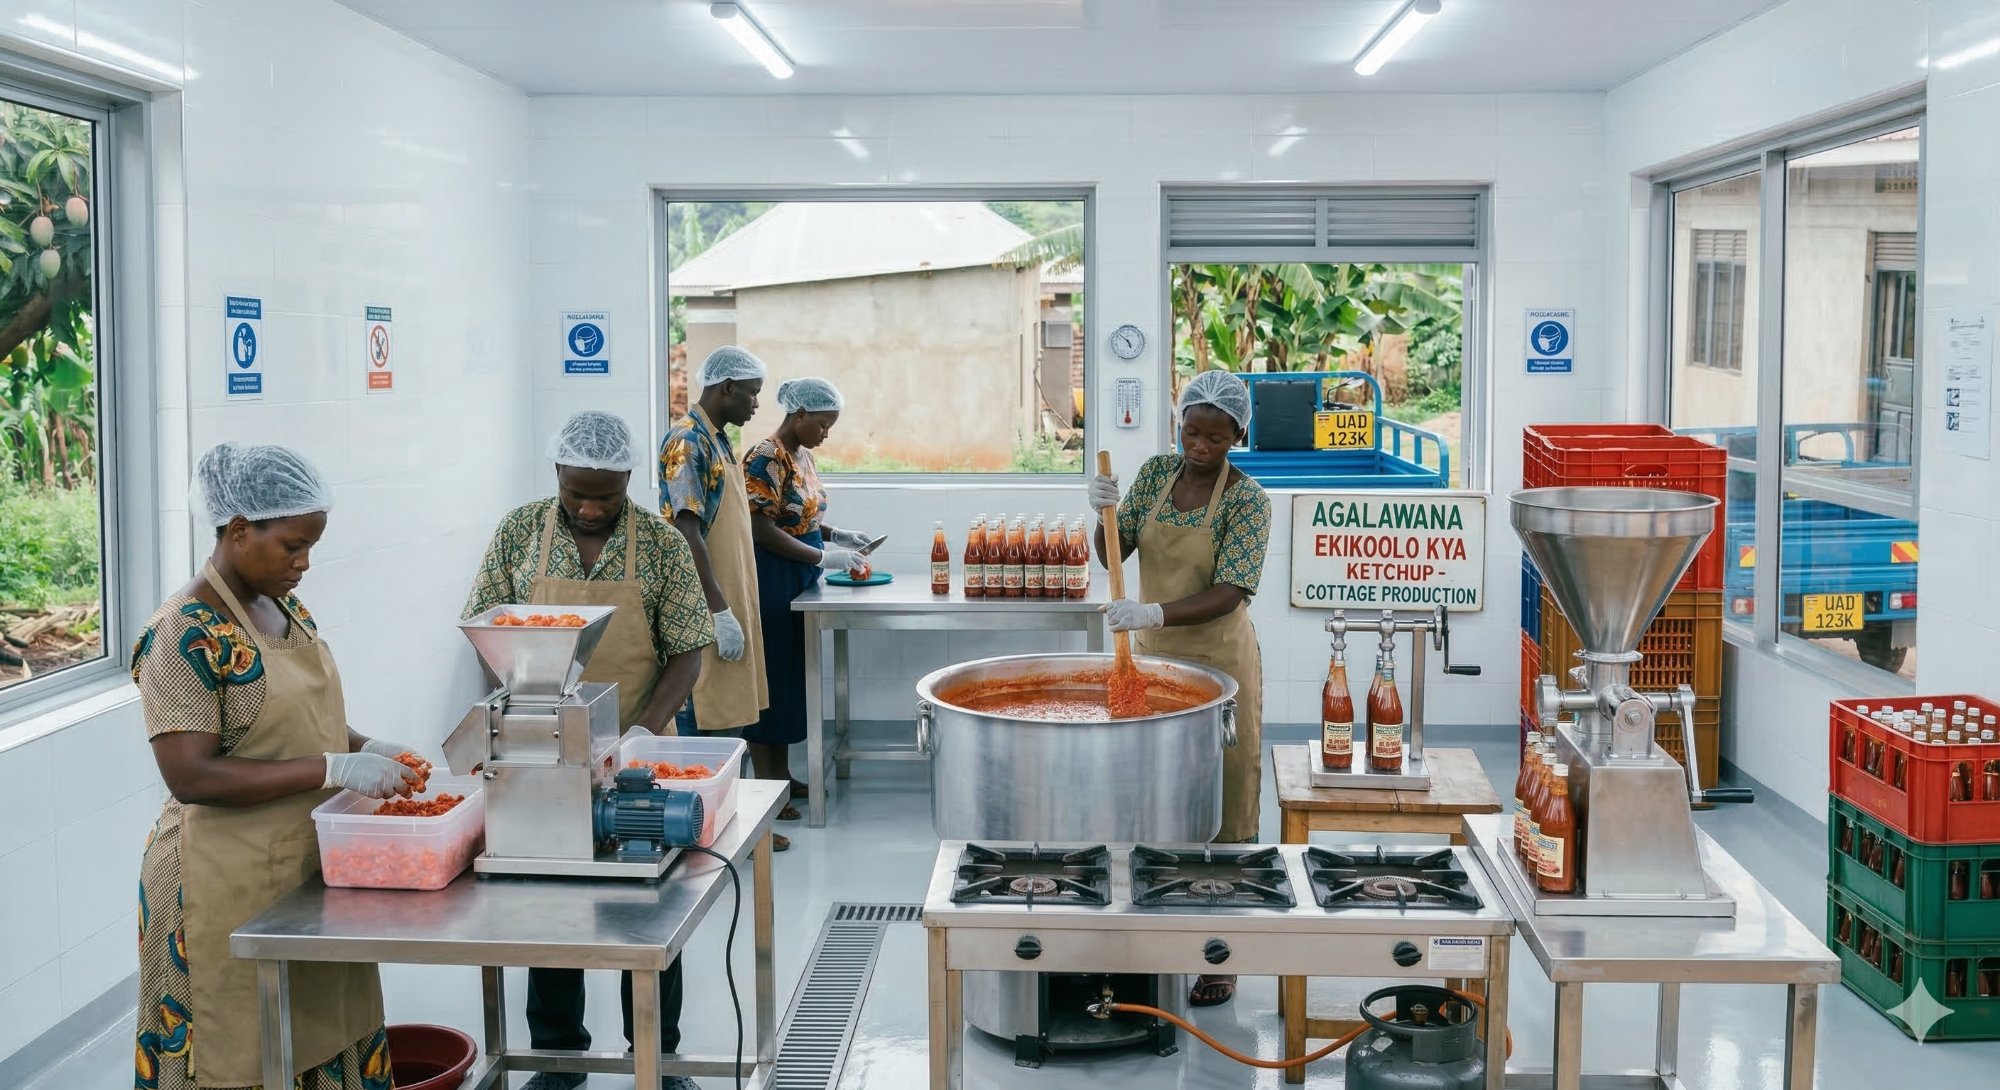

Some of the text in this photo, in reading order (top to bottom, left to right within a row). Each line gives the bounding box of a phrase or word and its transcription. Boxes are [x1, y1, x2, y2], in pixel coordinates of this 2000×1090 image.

[1337, 415, 1367, 428] UAD
[1328, 432, 1367, 446] 123K
[1312, 501, 1463, 530] AGALAWANA
[1315, 535, 1467, 561] EKIKOOLO KYA
[1305, 584, 1376, 602] COTTAGE
[1382, 585, 1476, 604] PRODUCTION
[1825, 595, 1855, 610] UAD
[1815, 613, 1854, 628] 123K
